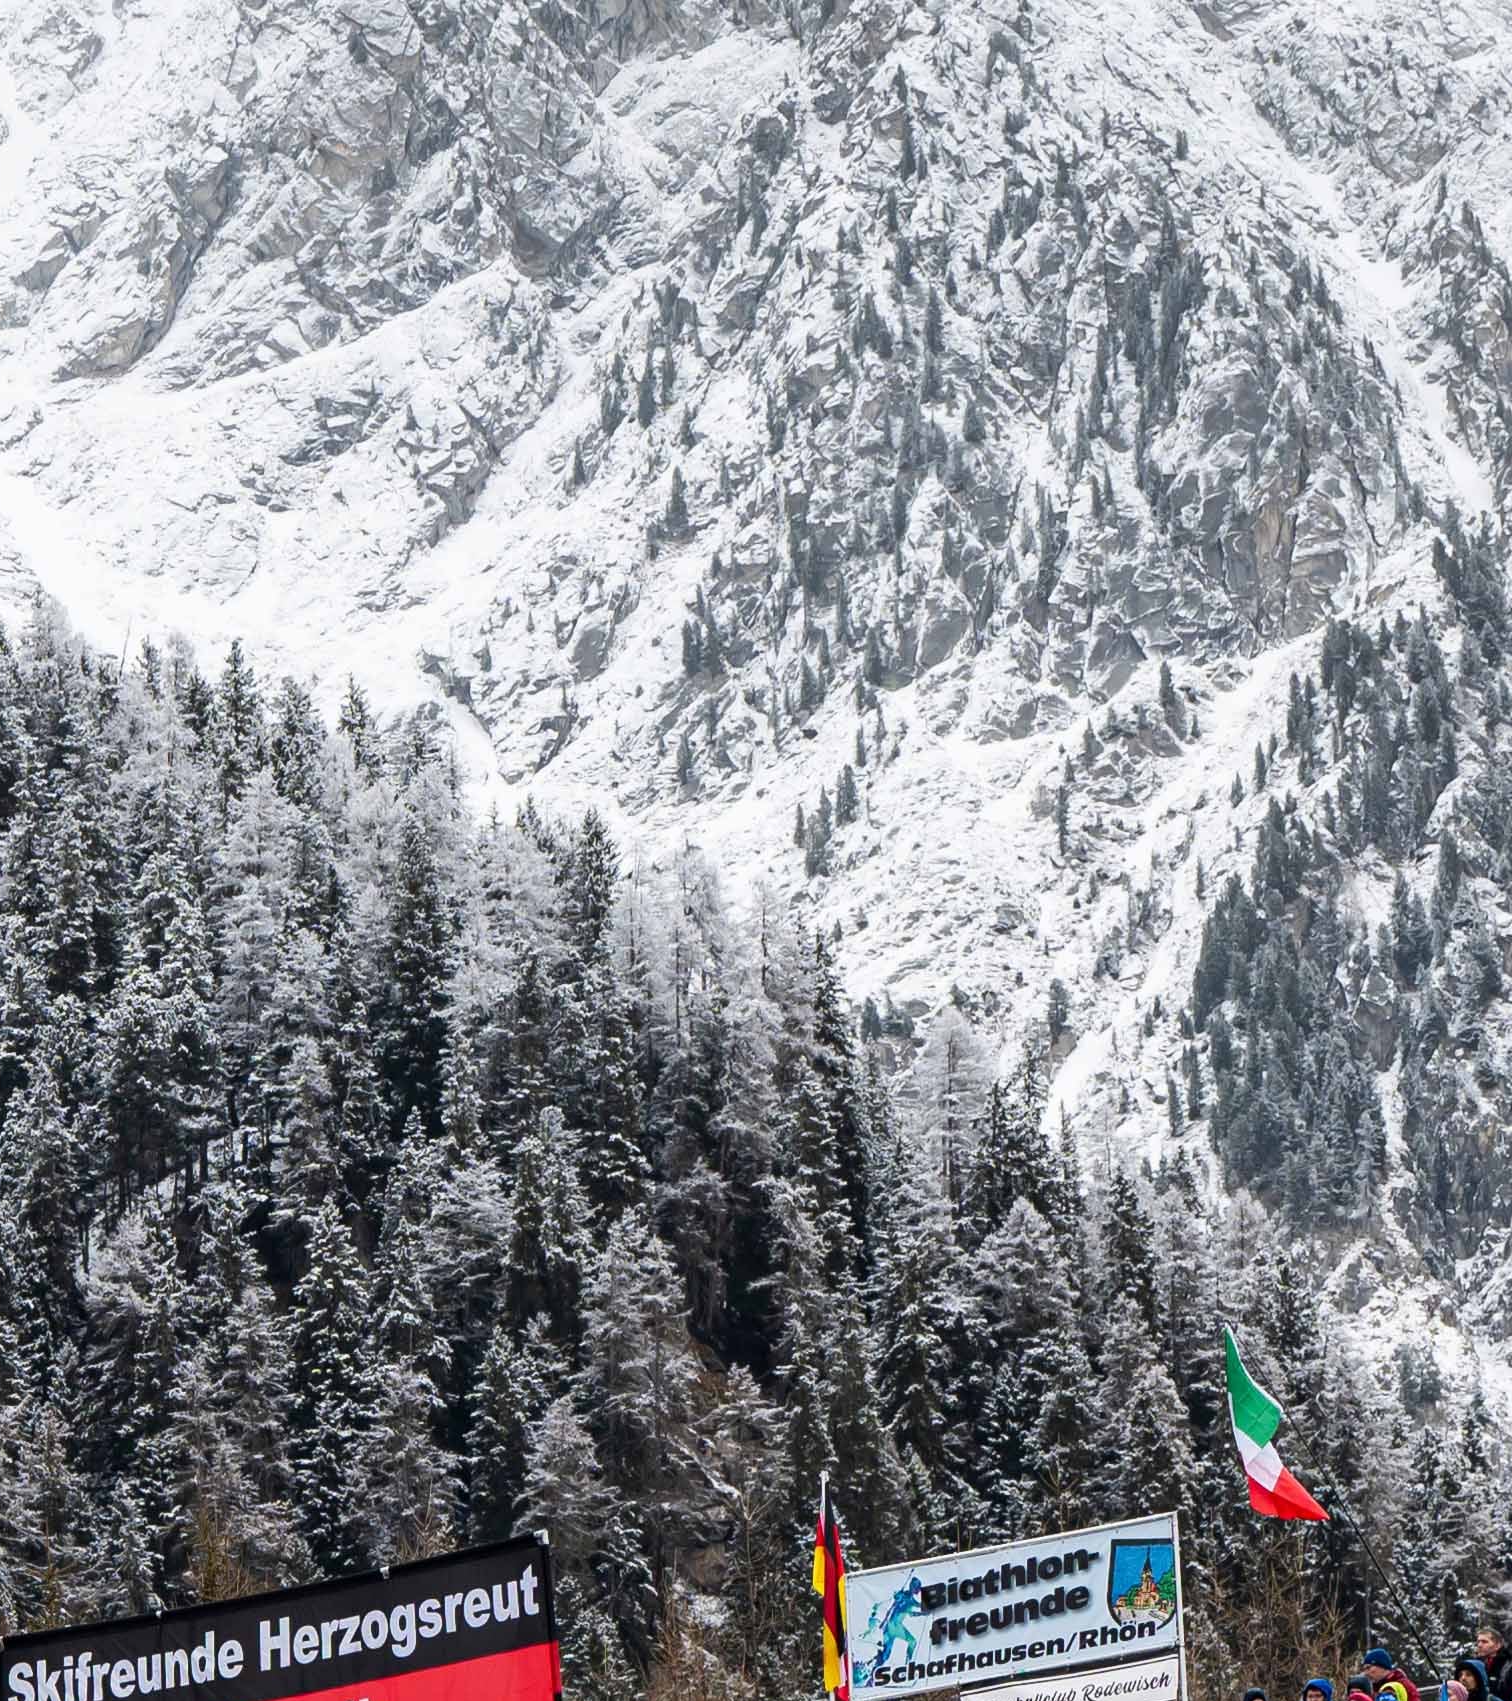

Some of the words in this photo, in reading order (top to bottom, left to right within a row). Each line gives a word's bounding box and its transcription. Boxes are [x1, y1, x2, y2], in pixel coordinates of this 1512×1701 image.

[921, 1547, 1099, 1611] Biathlon-
[259, 1565, 539, 1671] Herzogsreut
[930, 1583, 1089, 1645] freunde
[874, 1618, 1157, 1686] Schafhausen/Rhön
